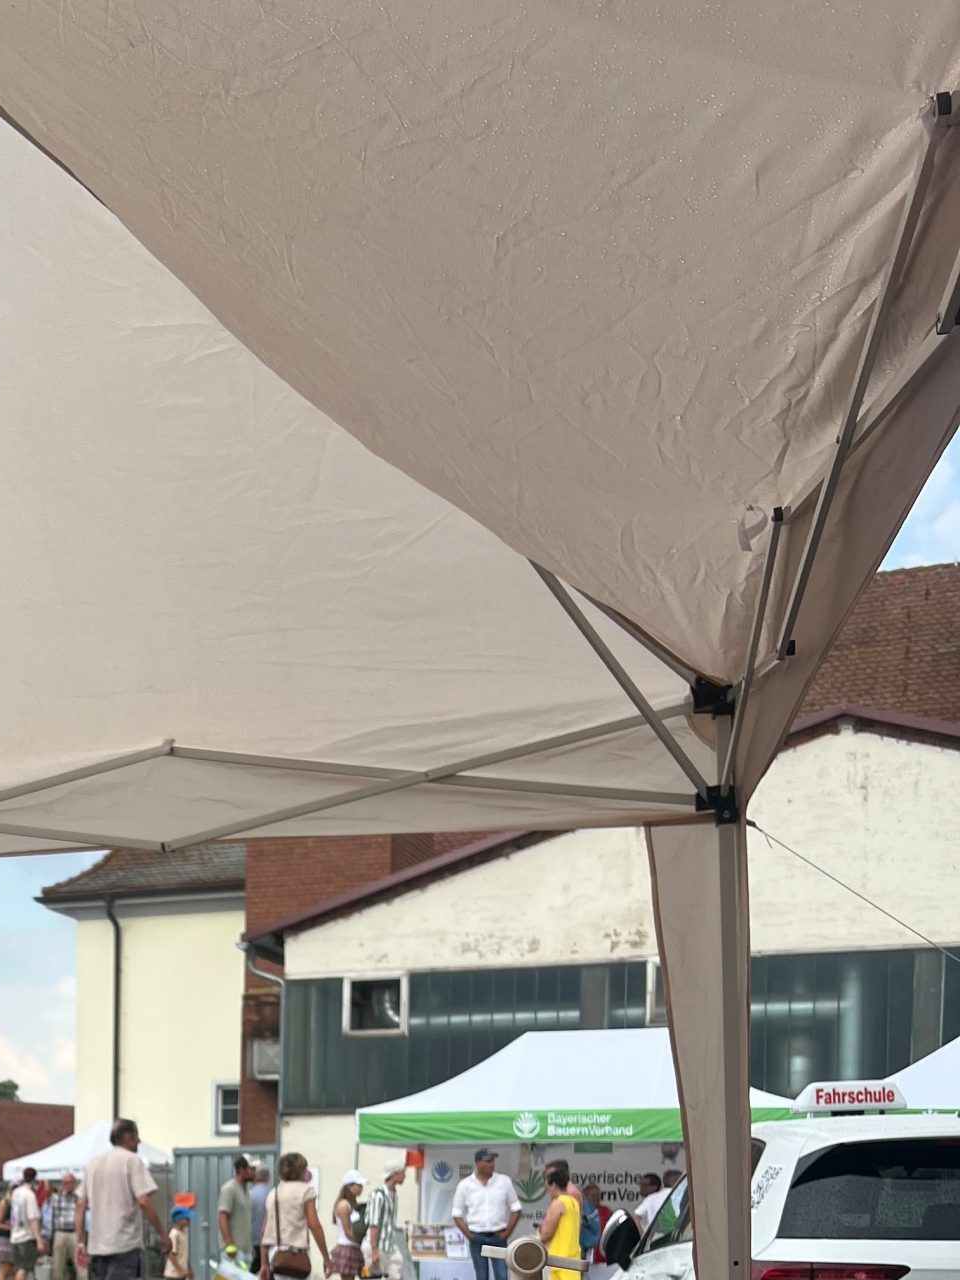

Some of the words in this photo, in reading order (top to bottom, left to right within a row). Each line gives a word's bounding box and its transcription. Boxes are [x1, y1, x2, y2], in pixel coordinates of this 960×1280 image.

[815, 1086, 895, 1105] Fahrschule
[547, 1112, 611, 1125] Bayerischer
[547, 1124, 634, 1137] BauernVerband
[570, 1170, 641, 1187] ayerische
